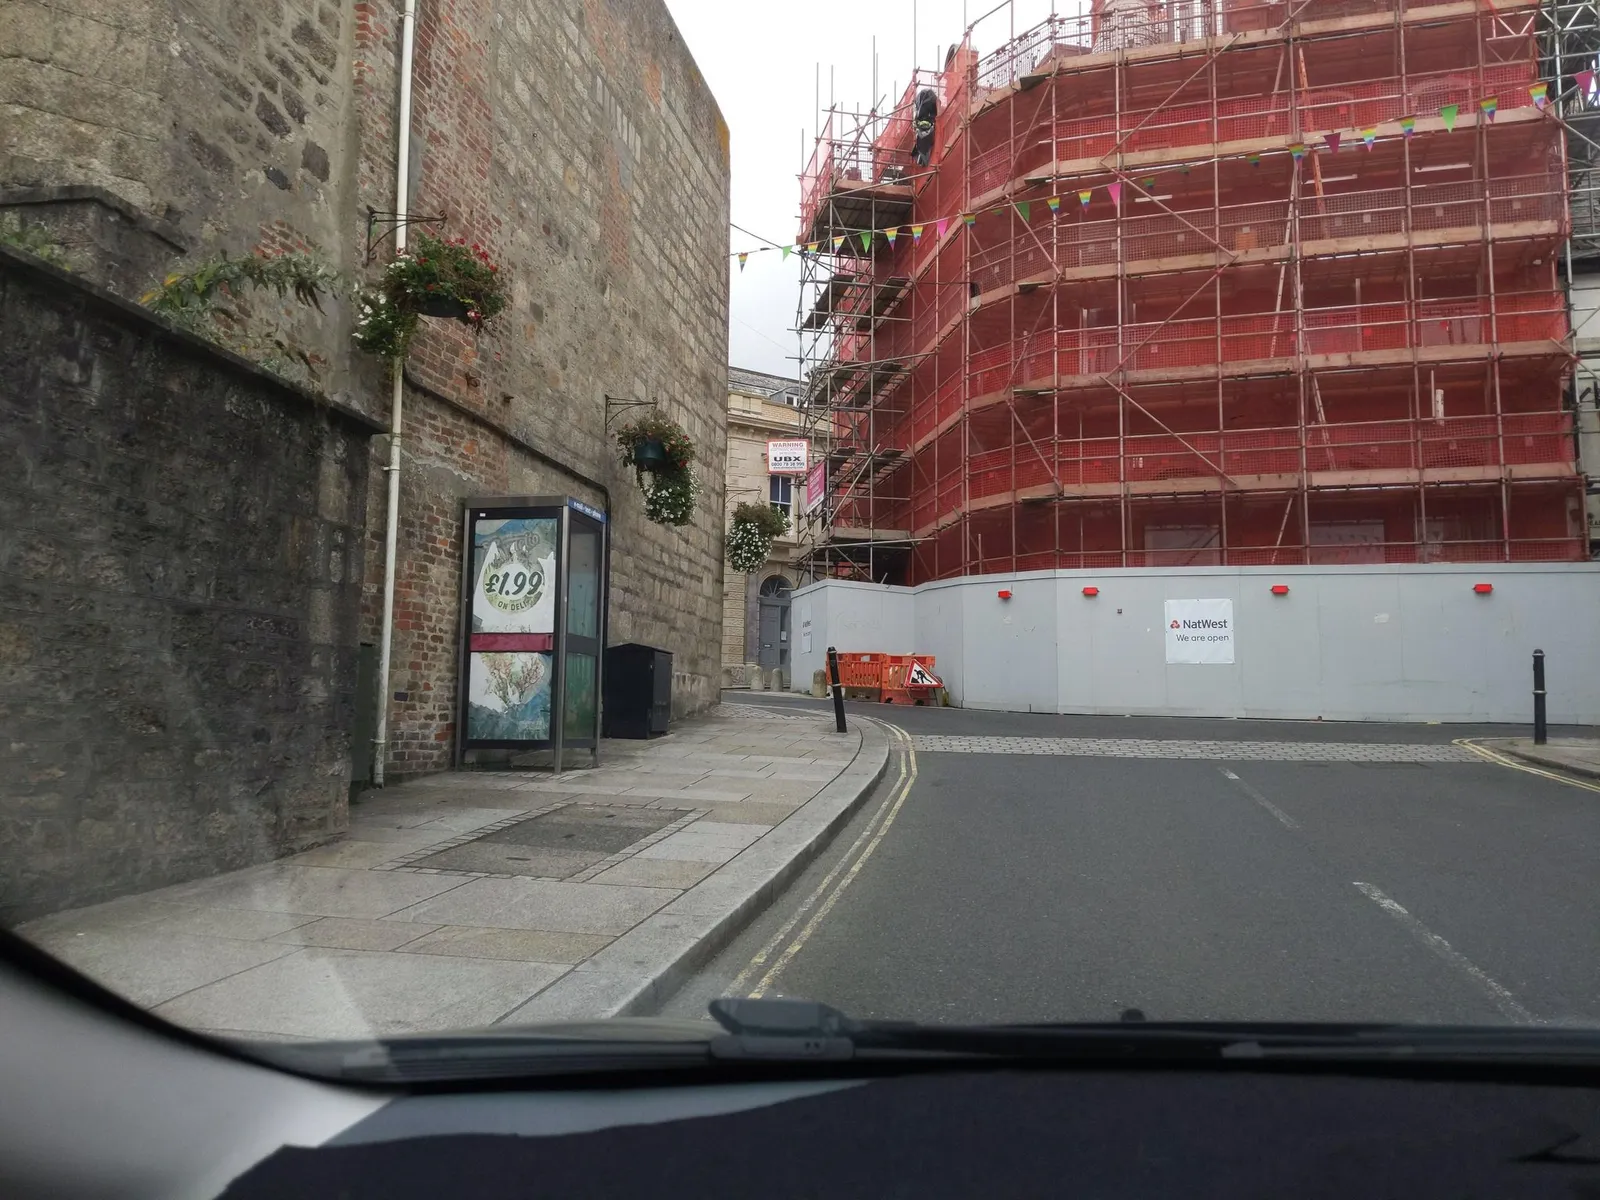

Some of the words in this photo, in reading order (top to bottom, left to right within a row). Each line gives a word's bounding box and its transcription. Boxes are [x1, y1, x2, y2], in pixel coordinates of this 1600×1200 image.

[485, 571, 543, 596] £1.99
[497, 601, 509, 610] ON
[1183, 619, 1228, 629] NatWest
[1176, 634, 1190, 642] We
[1207, 635, 1230, 643] open
